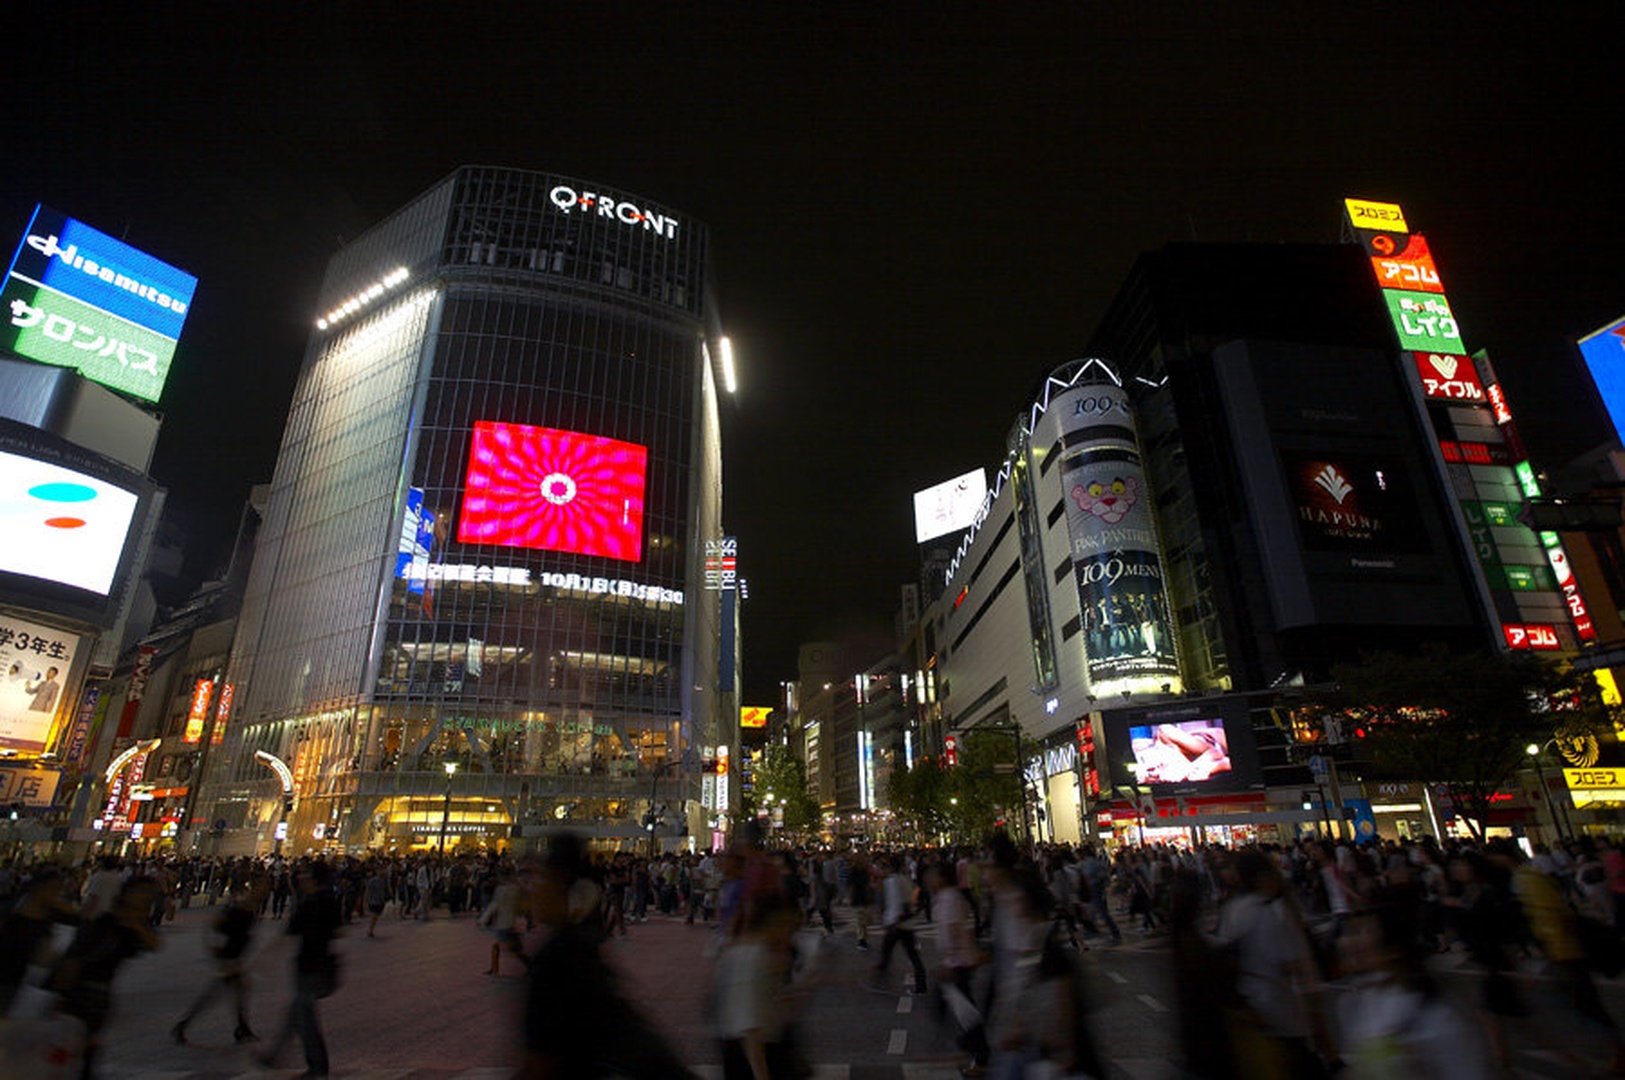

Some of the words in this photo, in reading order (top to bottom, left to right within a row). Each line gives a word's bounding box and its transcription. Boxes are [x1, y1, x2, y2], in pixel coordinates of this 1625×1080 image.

[550, 186, 679, 240] QFRONT
[26, 233, 187, 314] Hisamitsu
[1381, 261, 1440, 284] アコム
[9, 298, 158, 377] サロンパス
[1400, 313, 1459, 340] レイク
[1423, 378, 1481, 398] アイフル
[722, 539, 737, 589] SEIBU
[1081, 558, 1124, 587] 109
[1562, 584, 1586, 616] アコム
[1508, 626, 1558, 646] アコム
[1570, 769, 1618, 785] プロミス
